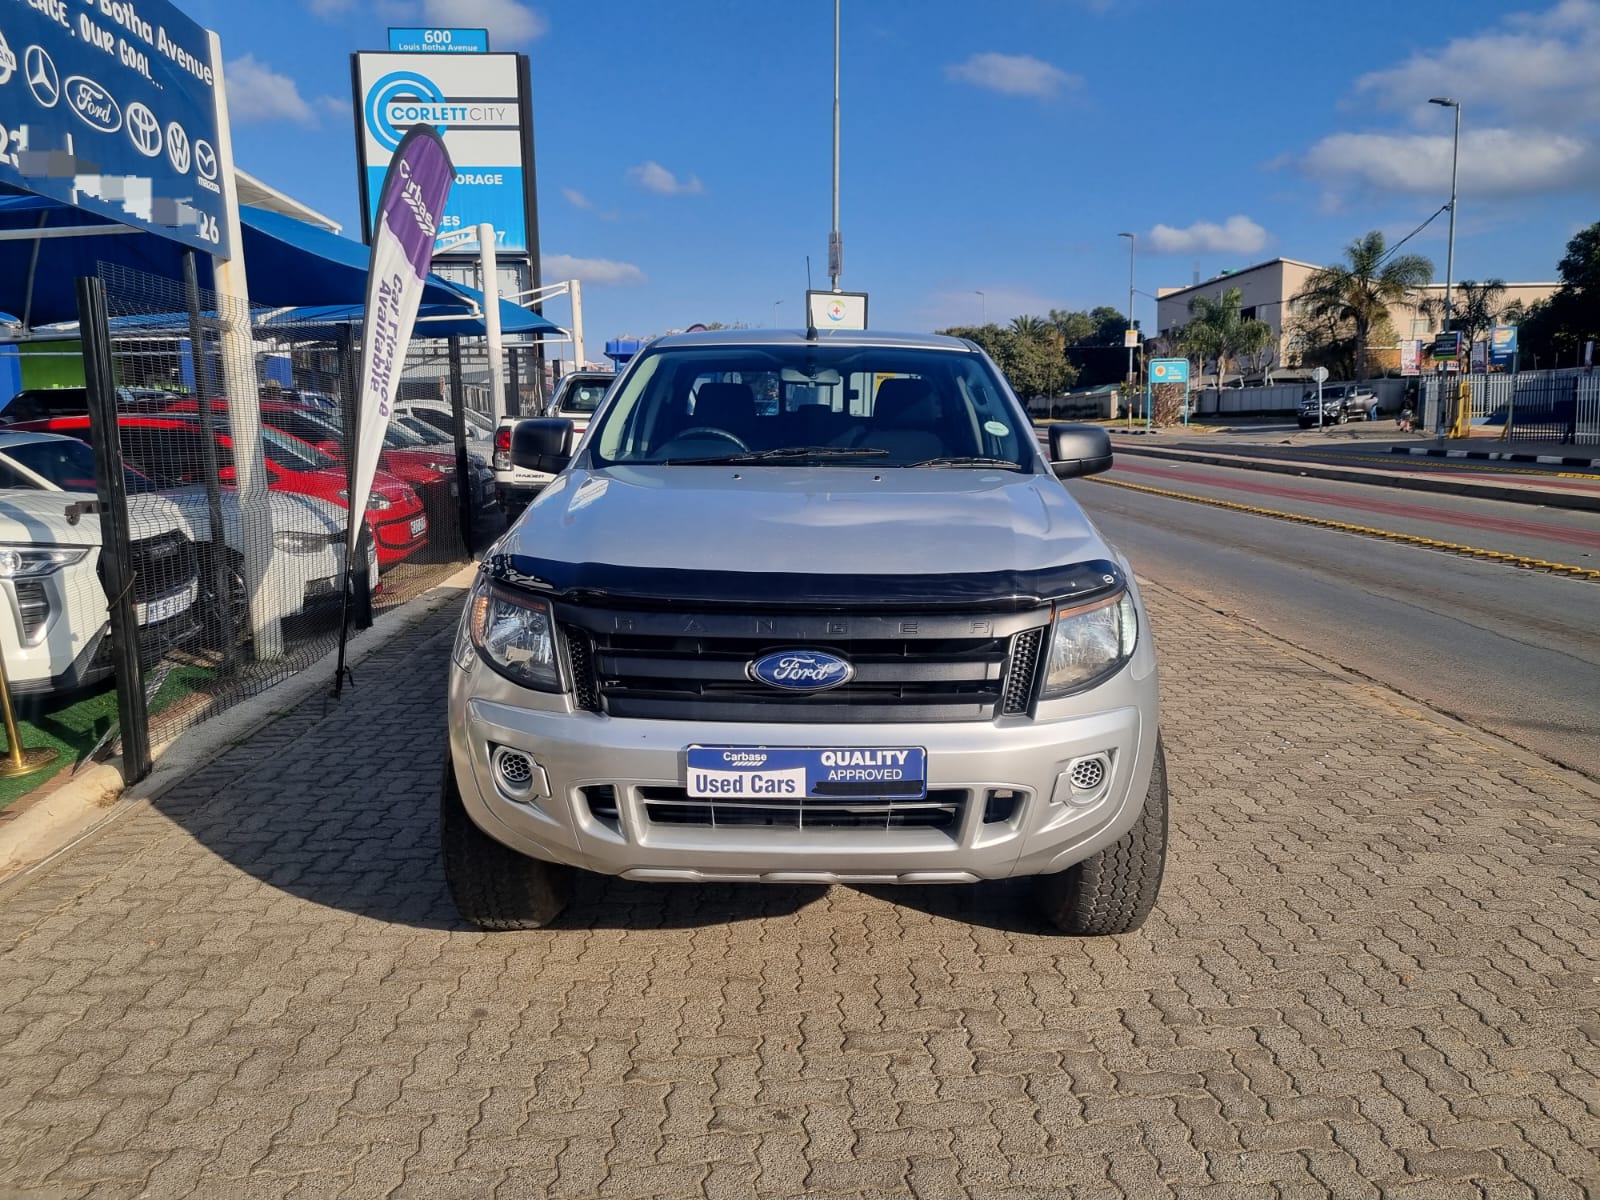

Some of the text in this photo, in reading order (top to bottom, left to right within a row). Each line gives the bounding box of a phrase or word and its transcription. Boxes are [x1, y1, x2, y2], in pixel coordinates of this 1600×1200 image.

[80, 13, 115, 56] OUR
[424, 29, 452, 44] 600
[157, 25, 213, 86] Avenue
[398, 43, 478, 52] Louis Botha Avenue
[76, 83, 112, 124] Ford
[455, 174, 503, 185] ORAGE
[390, 273, 403, 317] Car
[371, 279, 392, 393] Available
[613, 616, 992, 635] RANGER
[773, 657, 829, 681] Ford
[723, 751, 767, 762] Carbase
[820, 750, 909, 767] QUALITY
[695, 774, 796, 794] Used Cars
[827, 769, 903, 781] APPROVED
